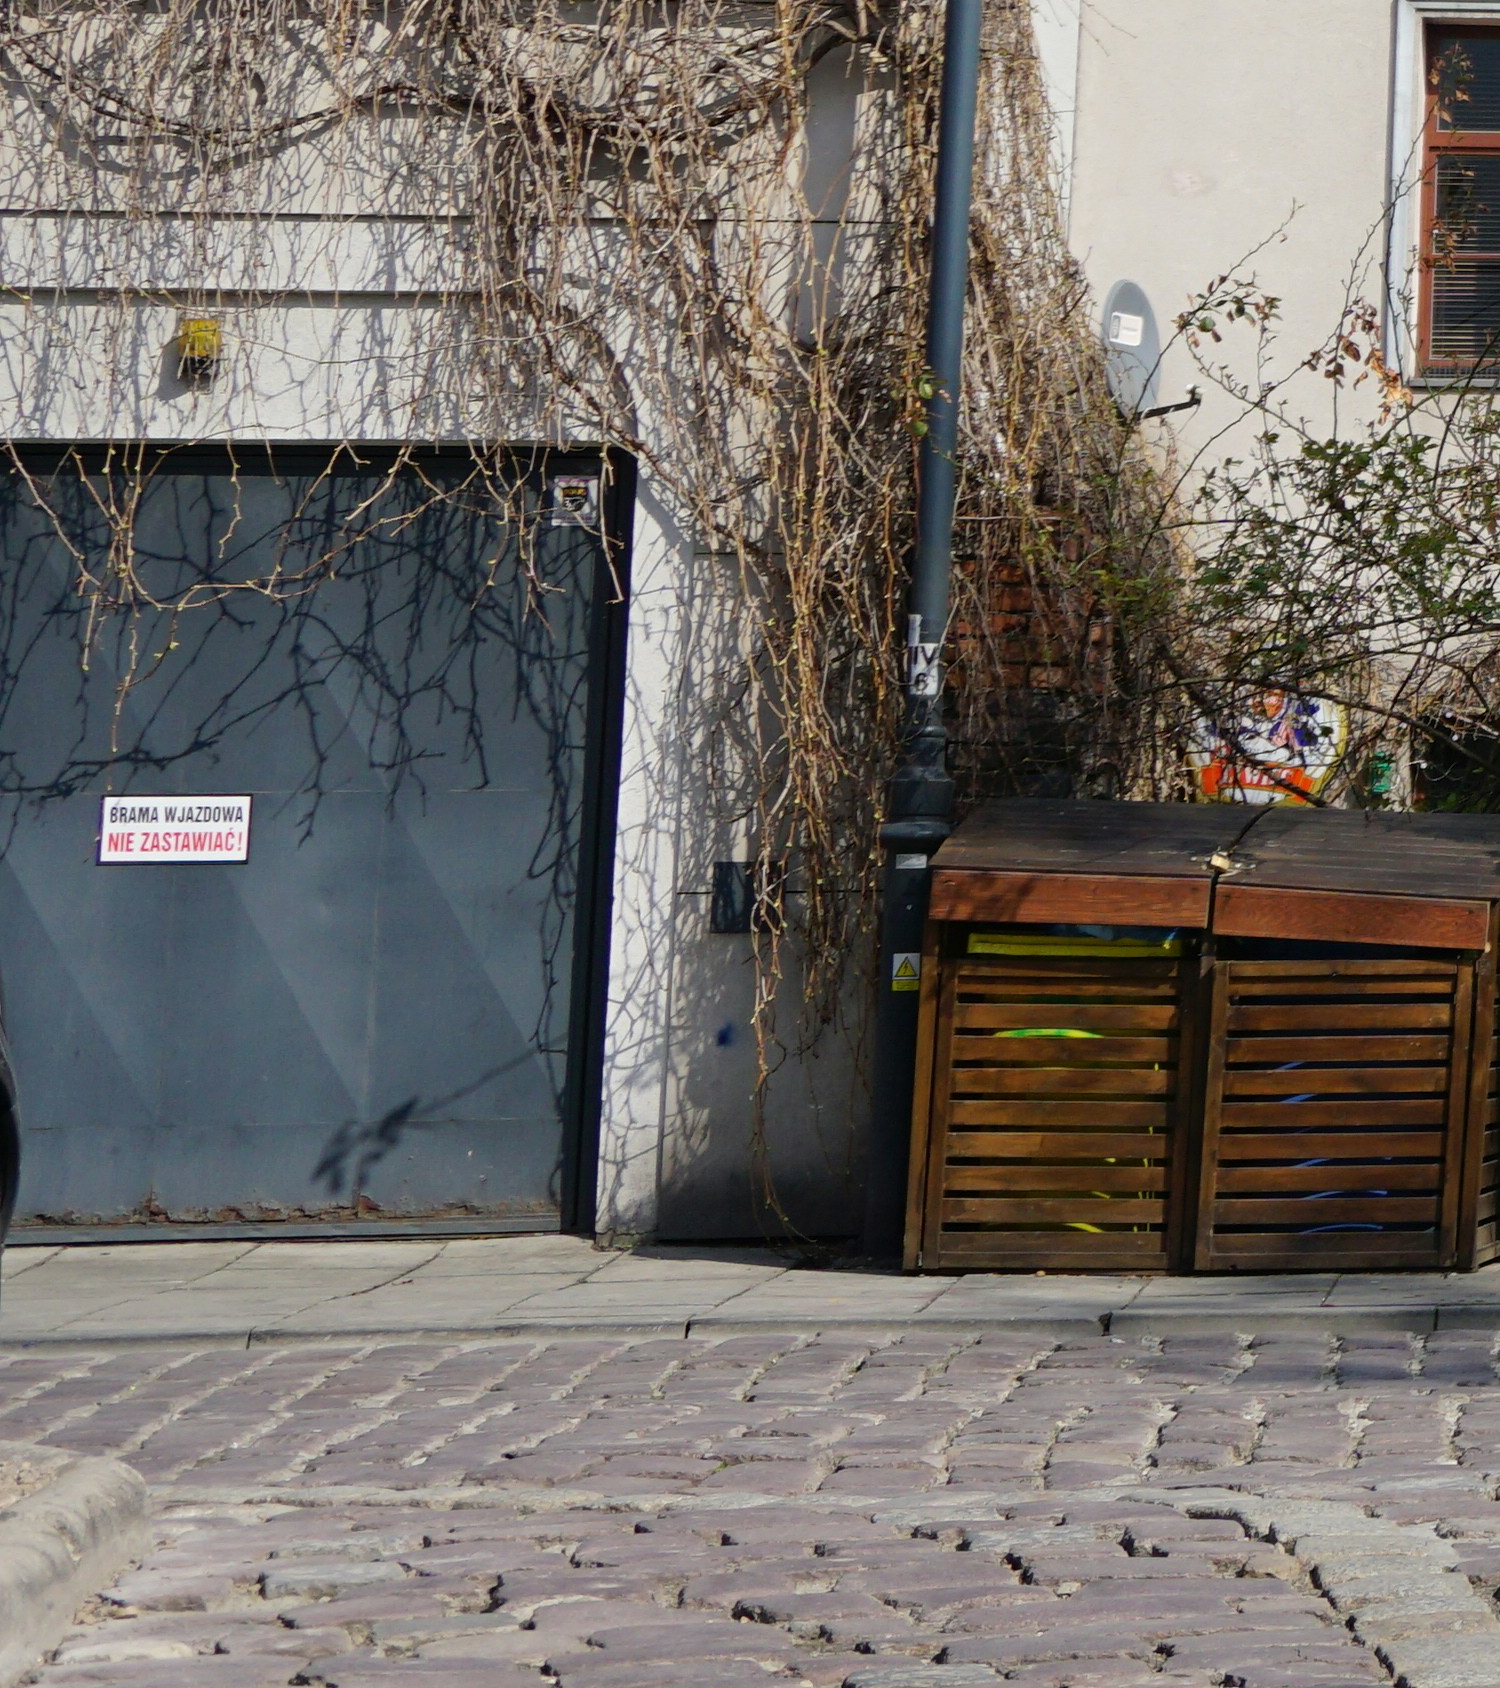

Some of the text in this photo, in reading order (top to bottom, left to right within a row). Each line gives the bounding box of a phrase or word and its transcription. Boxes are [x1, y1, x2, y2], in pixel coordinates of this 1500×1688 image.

[109, 806, 243, 823] BRAMA WJAZDOWA
[107, 827, 243, 852] NIE ZASTAWIAĆ!
